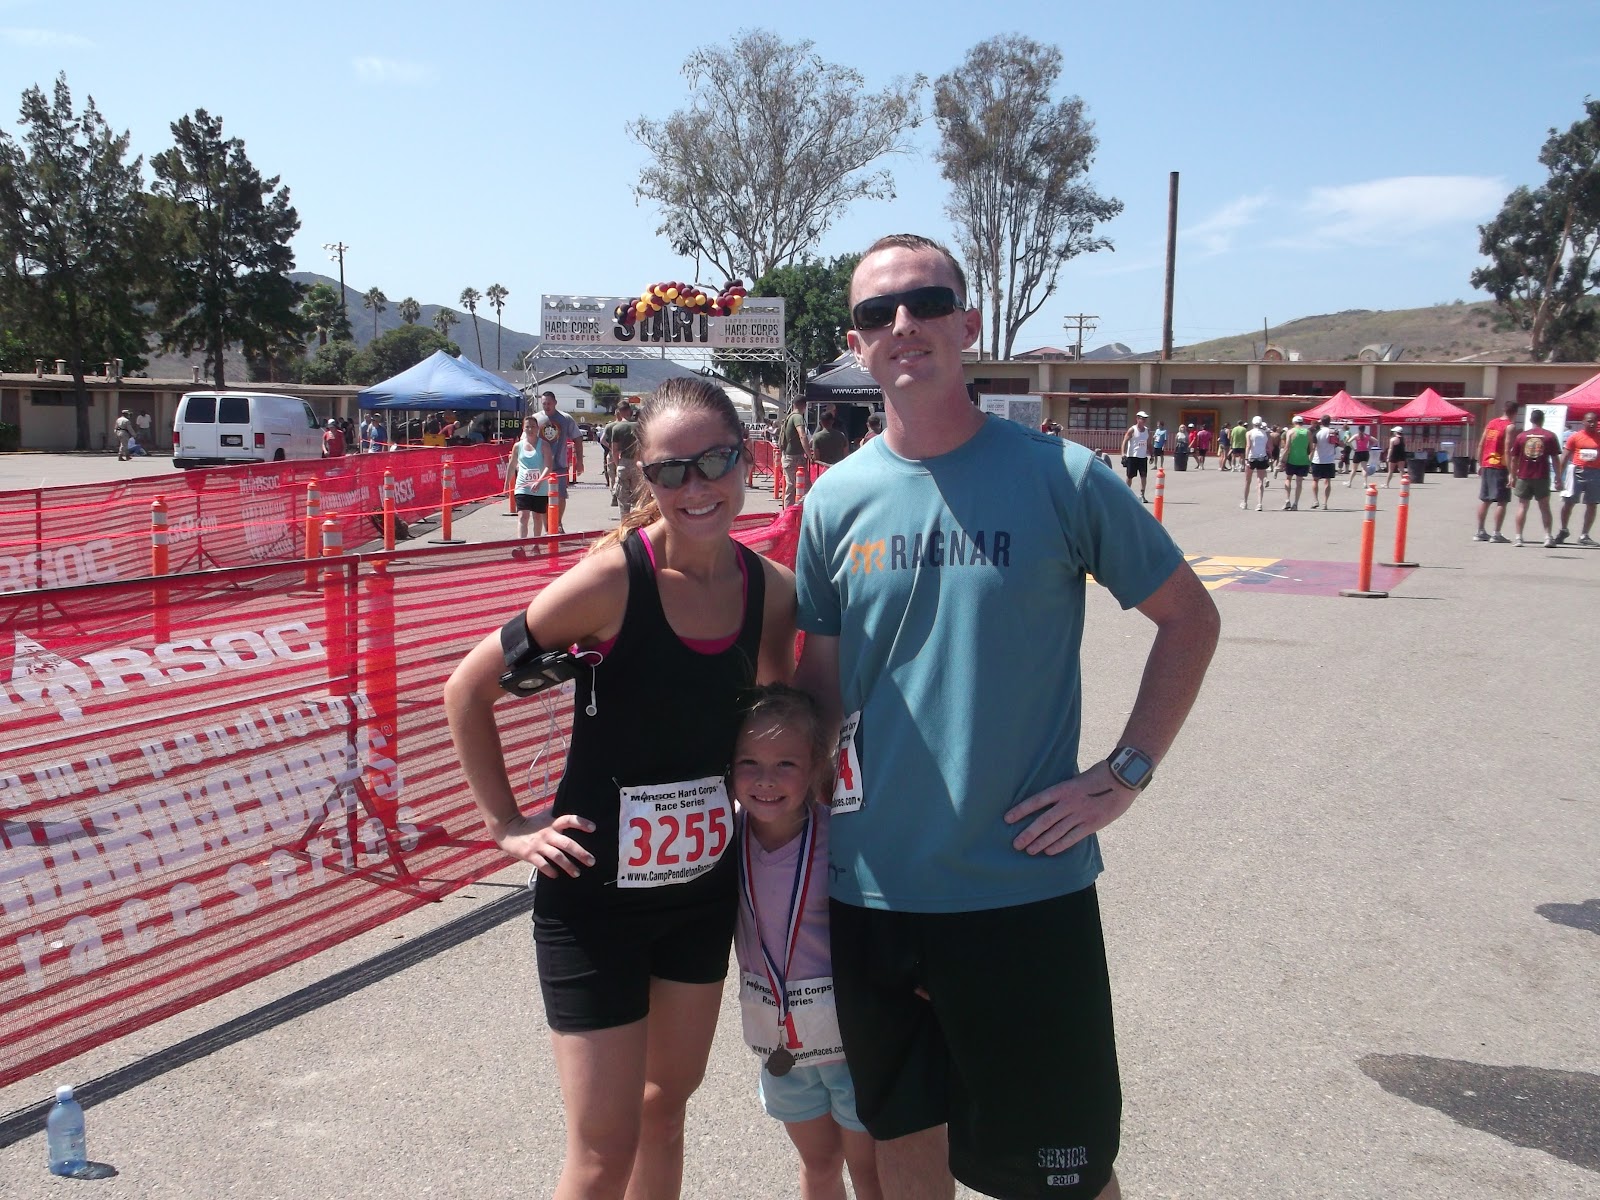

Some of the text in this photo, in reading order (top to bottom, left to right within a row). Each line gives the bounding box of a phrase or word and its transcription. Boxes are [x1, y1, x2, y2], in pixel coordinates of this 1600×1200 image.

[545, 321, 600, 334] HARD CORPS
[725, 324, 779, 336] HARD CORPS
[545, 333, 567, 341] race
[525, 472, 540, 481] 2561
[891, 530, 1011, 570] RAGNAR
[139, 691, 377, 778] pendleton
[837, 747, 854, 791] 4
[203, 728, 404, 850] CORPS
[678, 789, 697, 799] Hard
[698, 785, 718, 796] Corps
[655, 799, 705, 812] Race Series
[627, 807, 727, 867] 3255
[17, 806, 421, 993] race series
[788, 988, 802, 997] ard
[805, 984, 832, 996] Corps
[762, 996, 814, 1007] Rac eries
[1037, 1146, 1088, 1168] SENIOR
